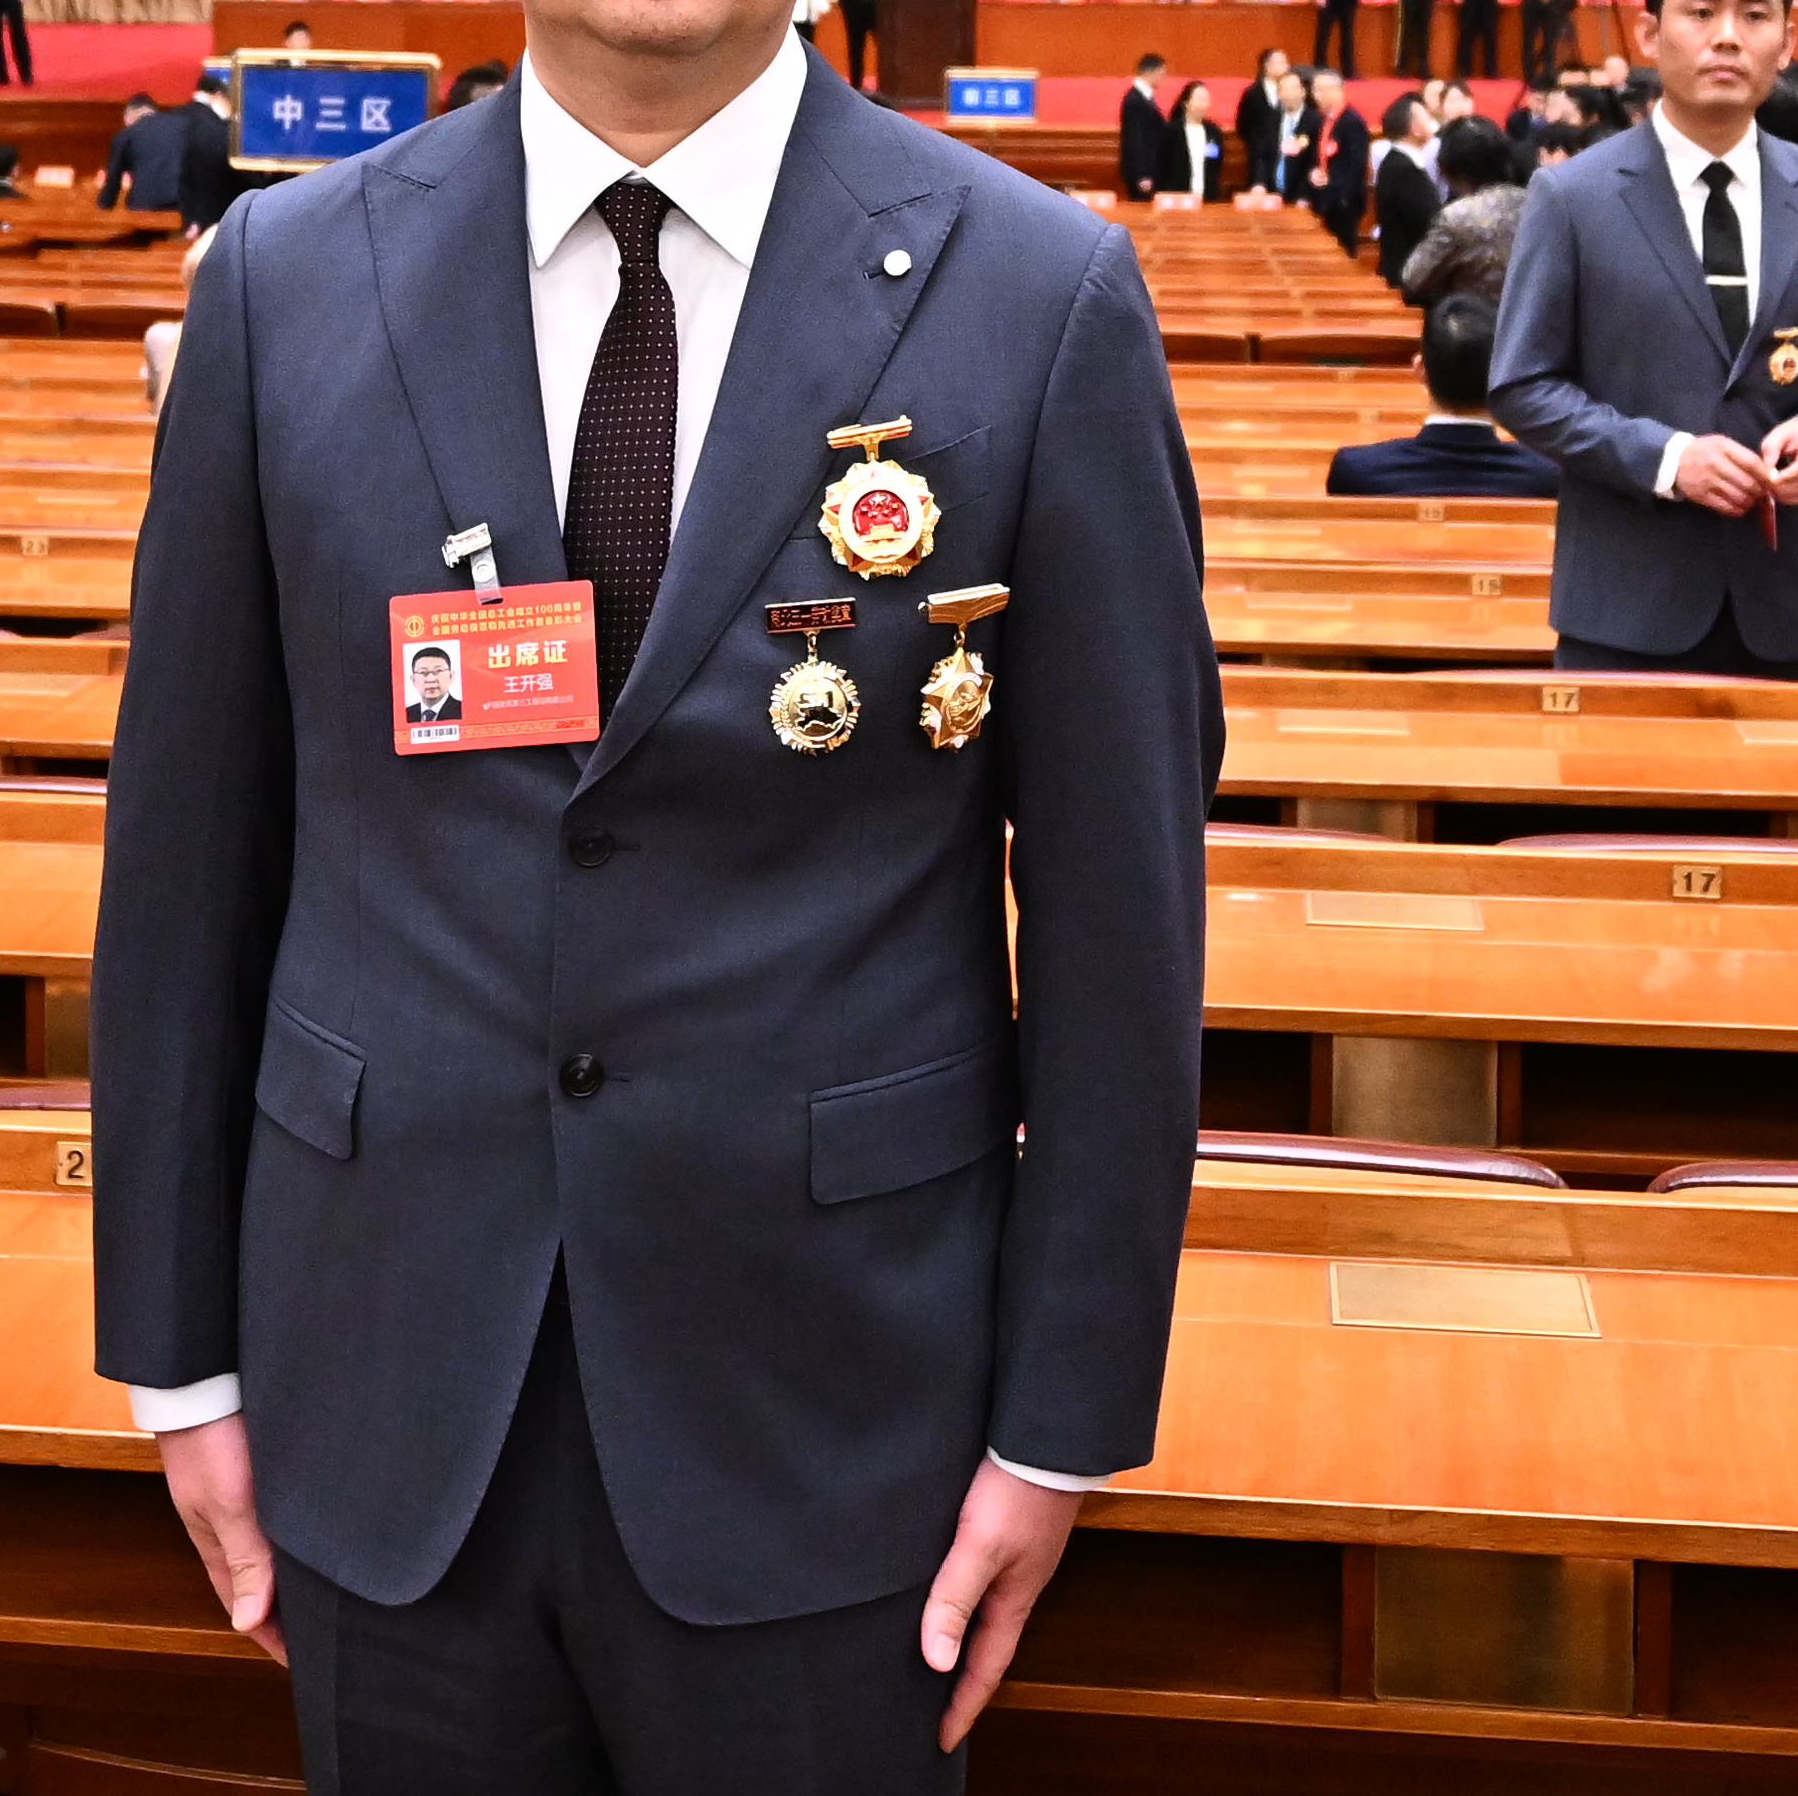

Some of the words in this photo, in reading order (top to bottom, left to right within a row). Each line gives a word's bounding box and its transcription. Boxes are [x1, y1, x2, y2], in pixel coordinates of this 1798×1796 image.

[272, 94, 392, 131] 中三区
[488, 640, 568, 669] 出席证
[503, 672, 554, 693] 王开强
[1550, 691, 1575, 708] 17
[1682, 871, 1717, 893] 17
[67, 1150, 85, 1180] 2
